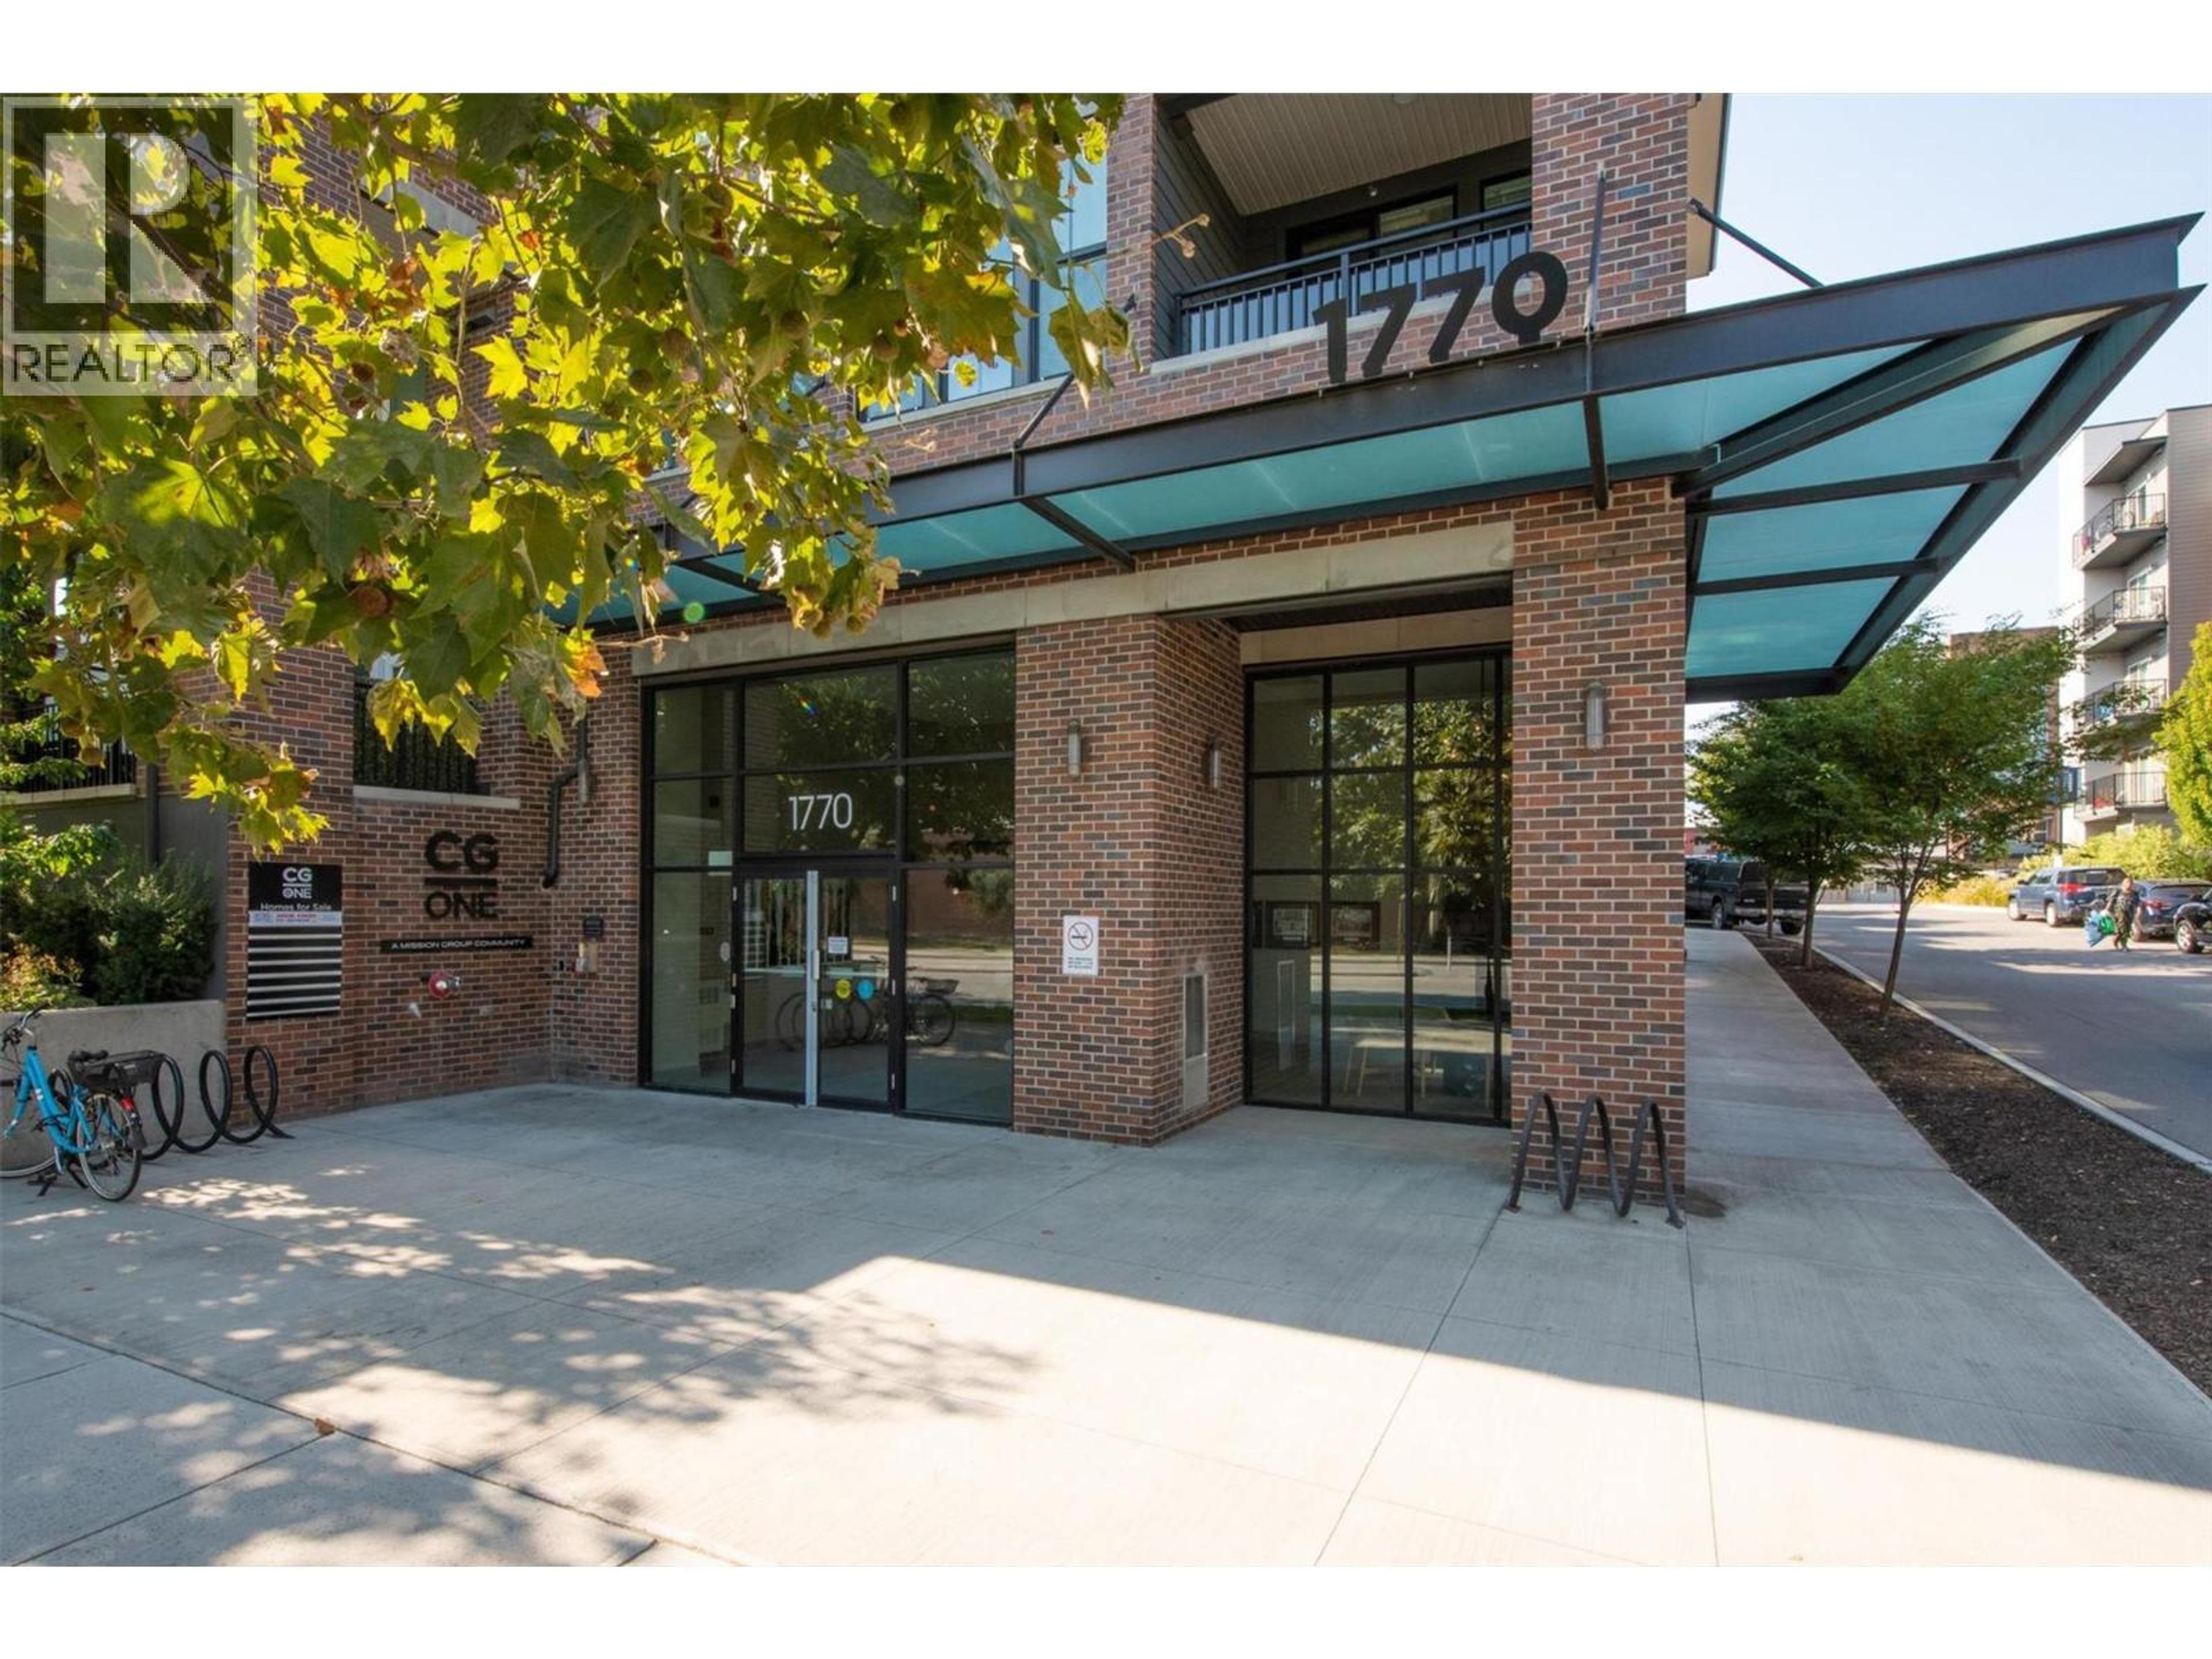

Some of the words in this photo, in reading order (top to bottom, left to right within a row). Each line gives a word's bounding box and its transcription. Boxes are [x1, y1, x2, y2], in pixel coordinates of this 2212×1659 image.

[1312, 251, 1568, 384] 1770
[788, 793, 853, 830] 1770
[425, 830, 499, 874] CG
[282, 866, 313, 882] CG
[282, 887, 312, 899] ONE
[260, 903, 293, 911] Homes
[297, 903, 310, 911] for
[423, 891, 498, 920] ONE
[441, 940, 472, 948] GROUP
[474, 939, 525, 948] COMMUNITY
